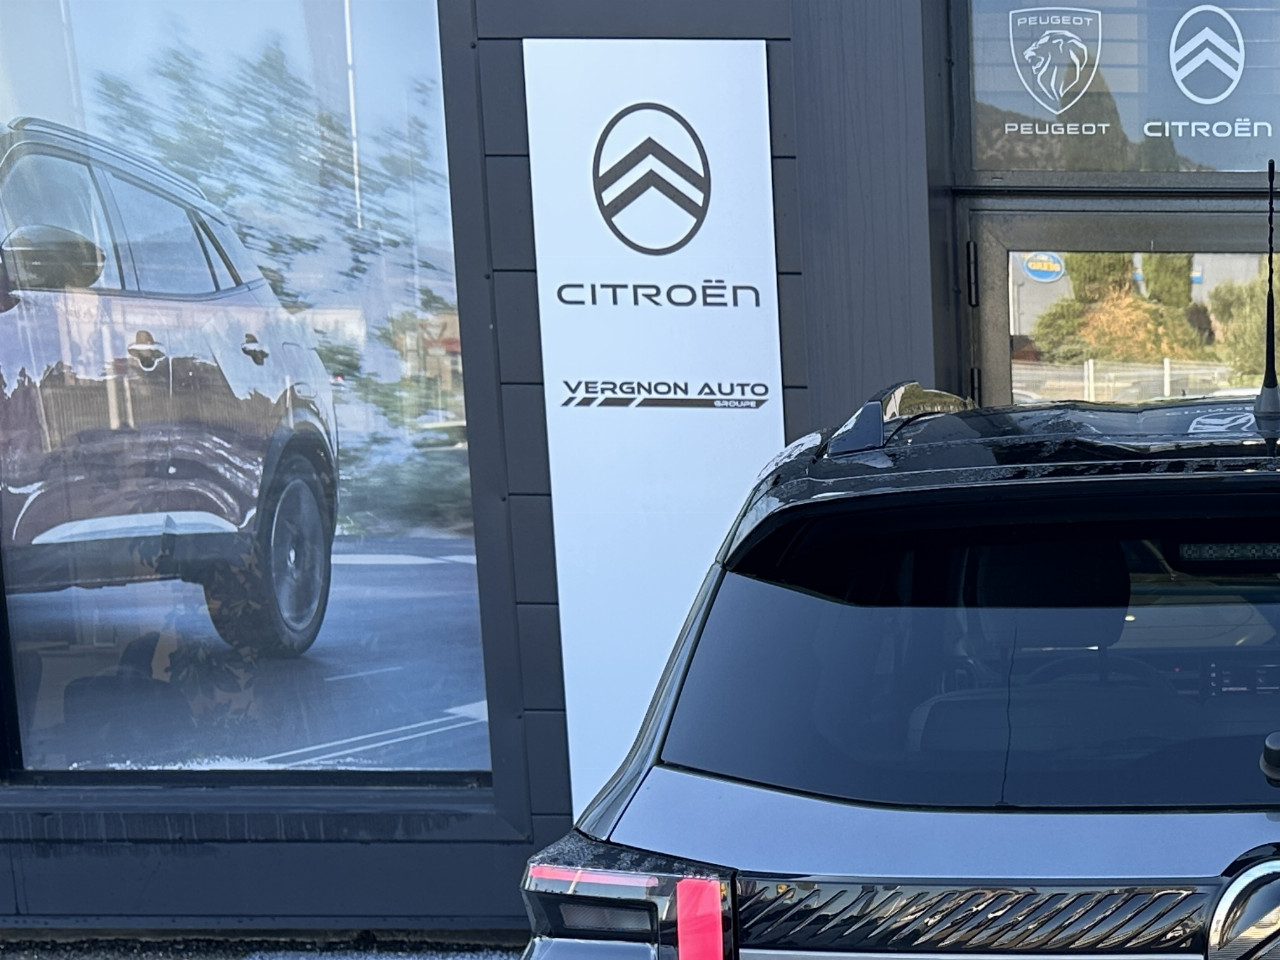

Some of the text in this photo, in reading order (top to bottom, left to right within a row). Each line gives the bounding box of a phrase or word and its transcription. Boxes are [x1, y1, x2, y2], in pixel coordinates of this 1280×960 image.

[1017, 15, 1094, 27] PEUGEOT
[1004, 122, 1111, 135] PEUGEOT
[1142, 118, 1273, 138] CITROËN
[556, 279, 761, 307] CITROËN
[562, 381, 770, 397] VERGNON AUTO
[713, 400, 757, 408] GROUPE
